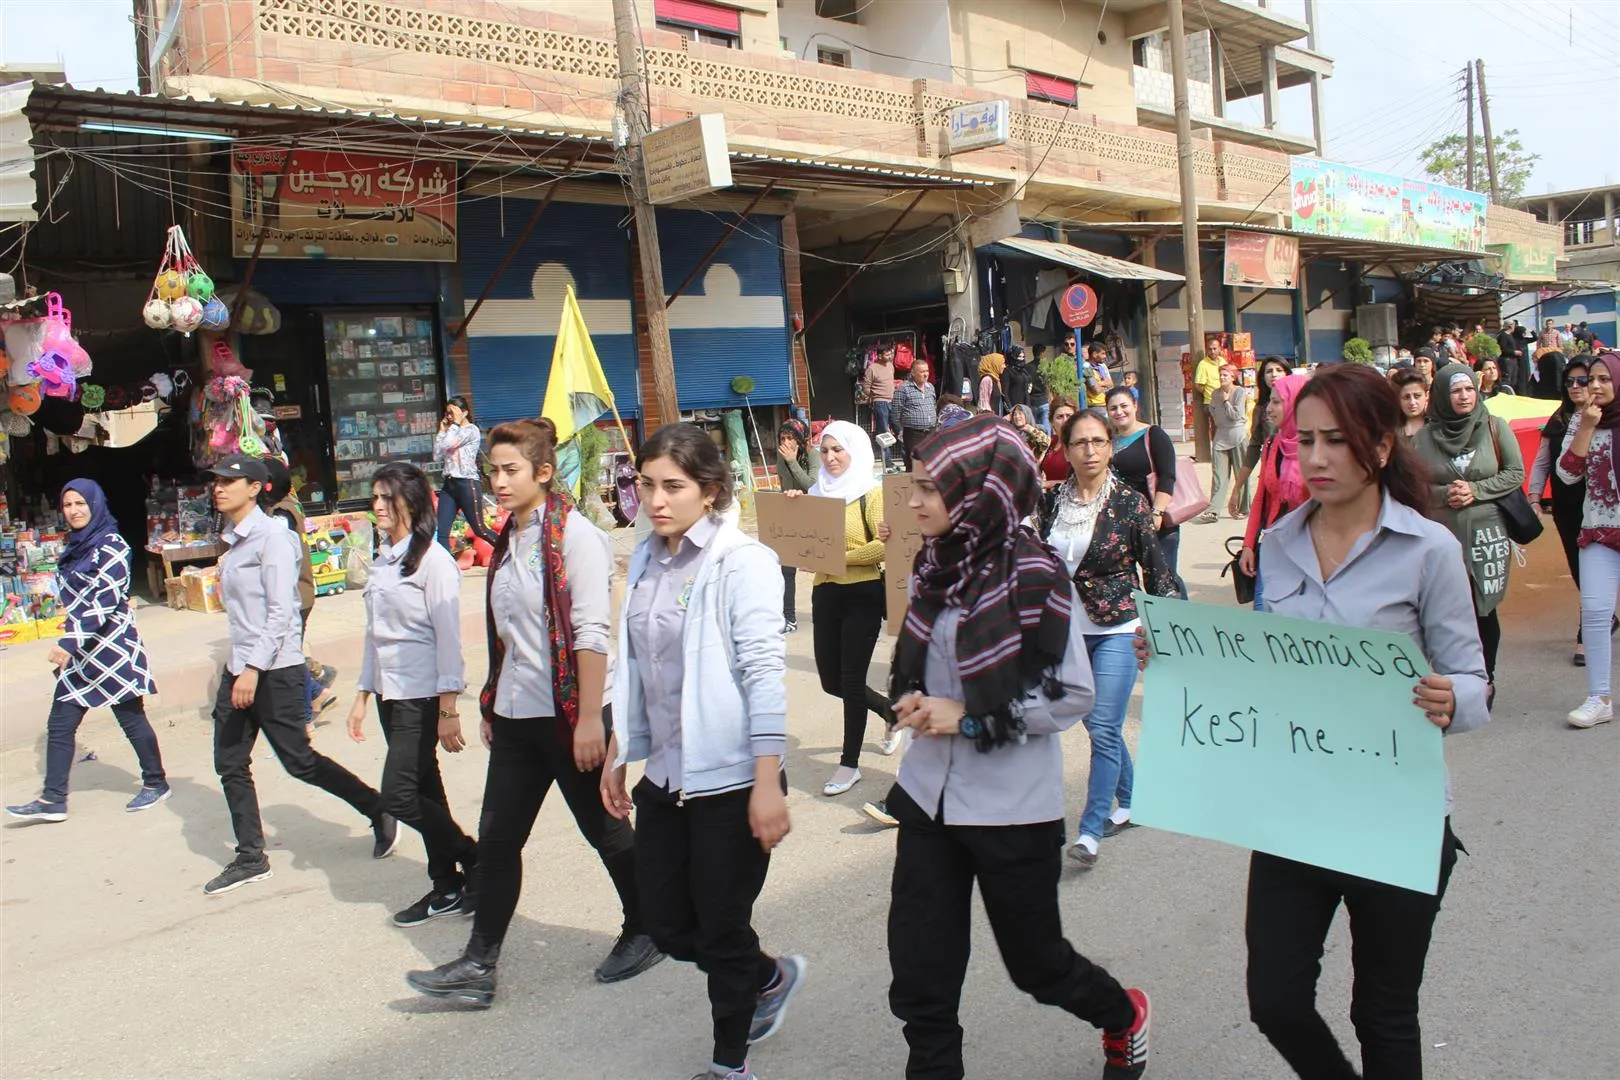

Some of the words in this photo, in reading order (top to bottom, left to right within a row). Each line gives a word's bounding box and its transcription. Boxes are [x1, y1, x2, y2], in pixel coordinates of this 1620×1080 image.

[288, 159, 372, 197] روجين
[377, 162, 448, 200] شركة
[1475, 525, 1506, 545] ALL
[1471, 540, 1510, 562] EYES
[1483, 560, 1505, 577] ON
[1483, 576, 1505, 595] ME
[1142, 600, 1204, 657] Em
[1213, 625, 1255, 663] ne
[1263, 631, 1423, 679] namûsa
